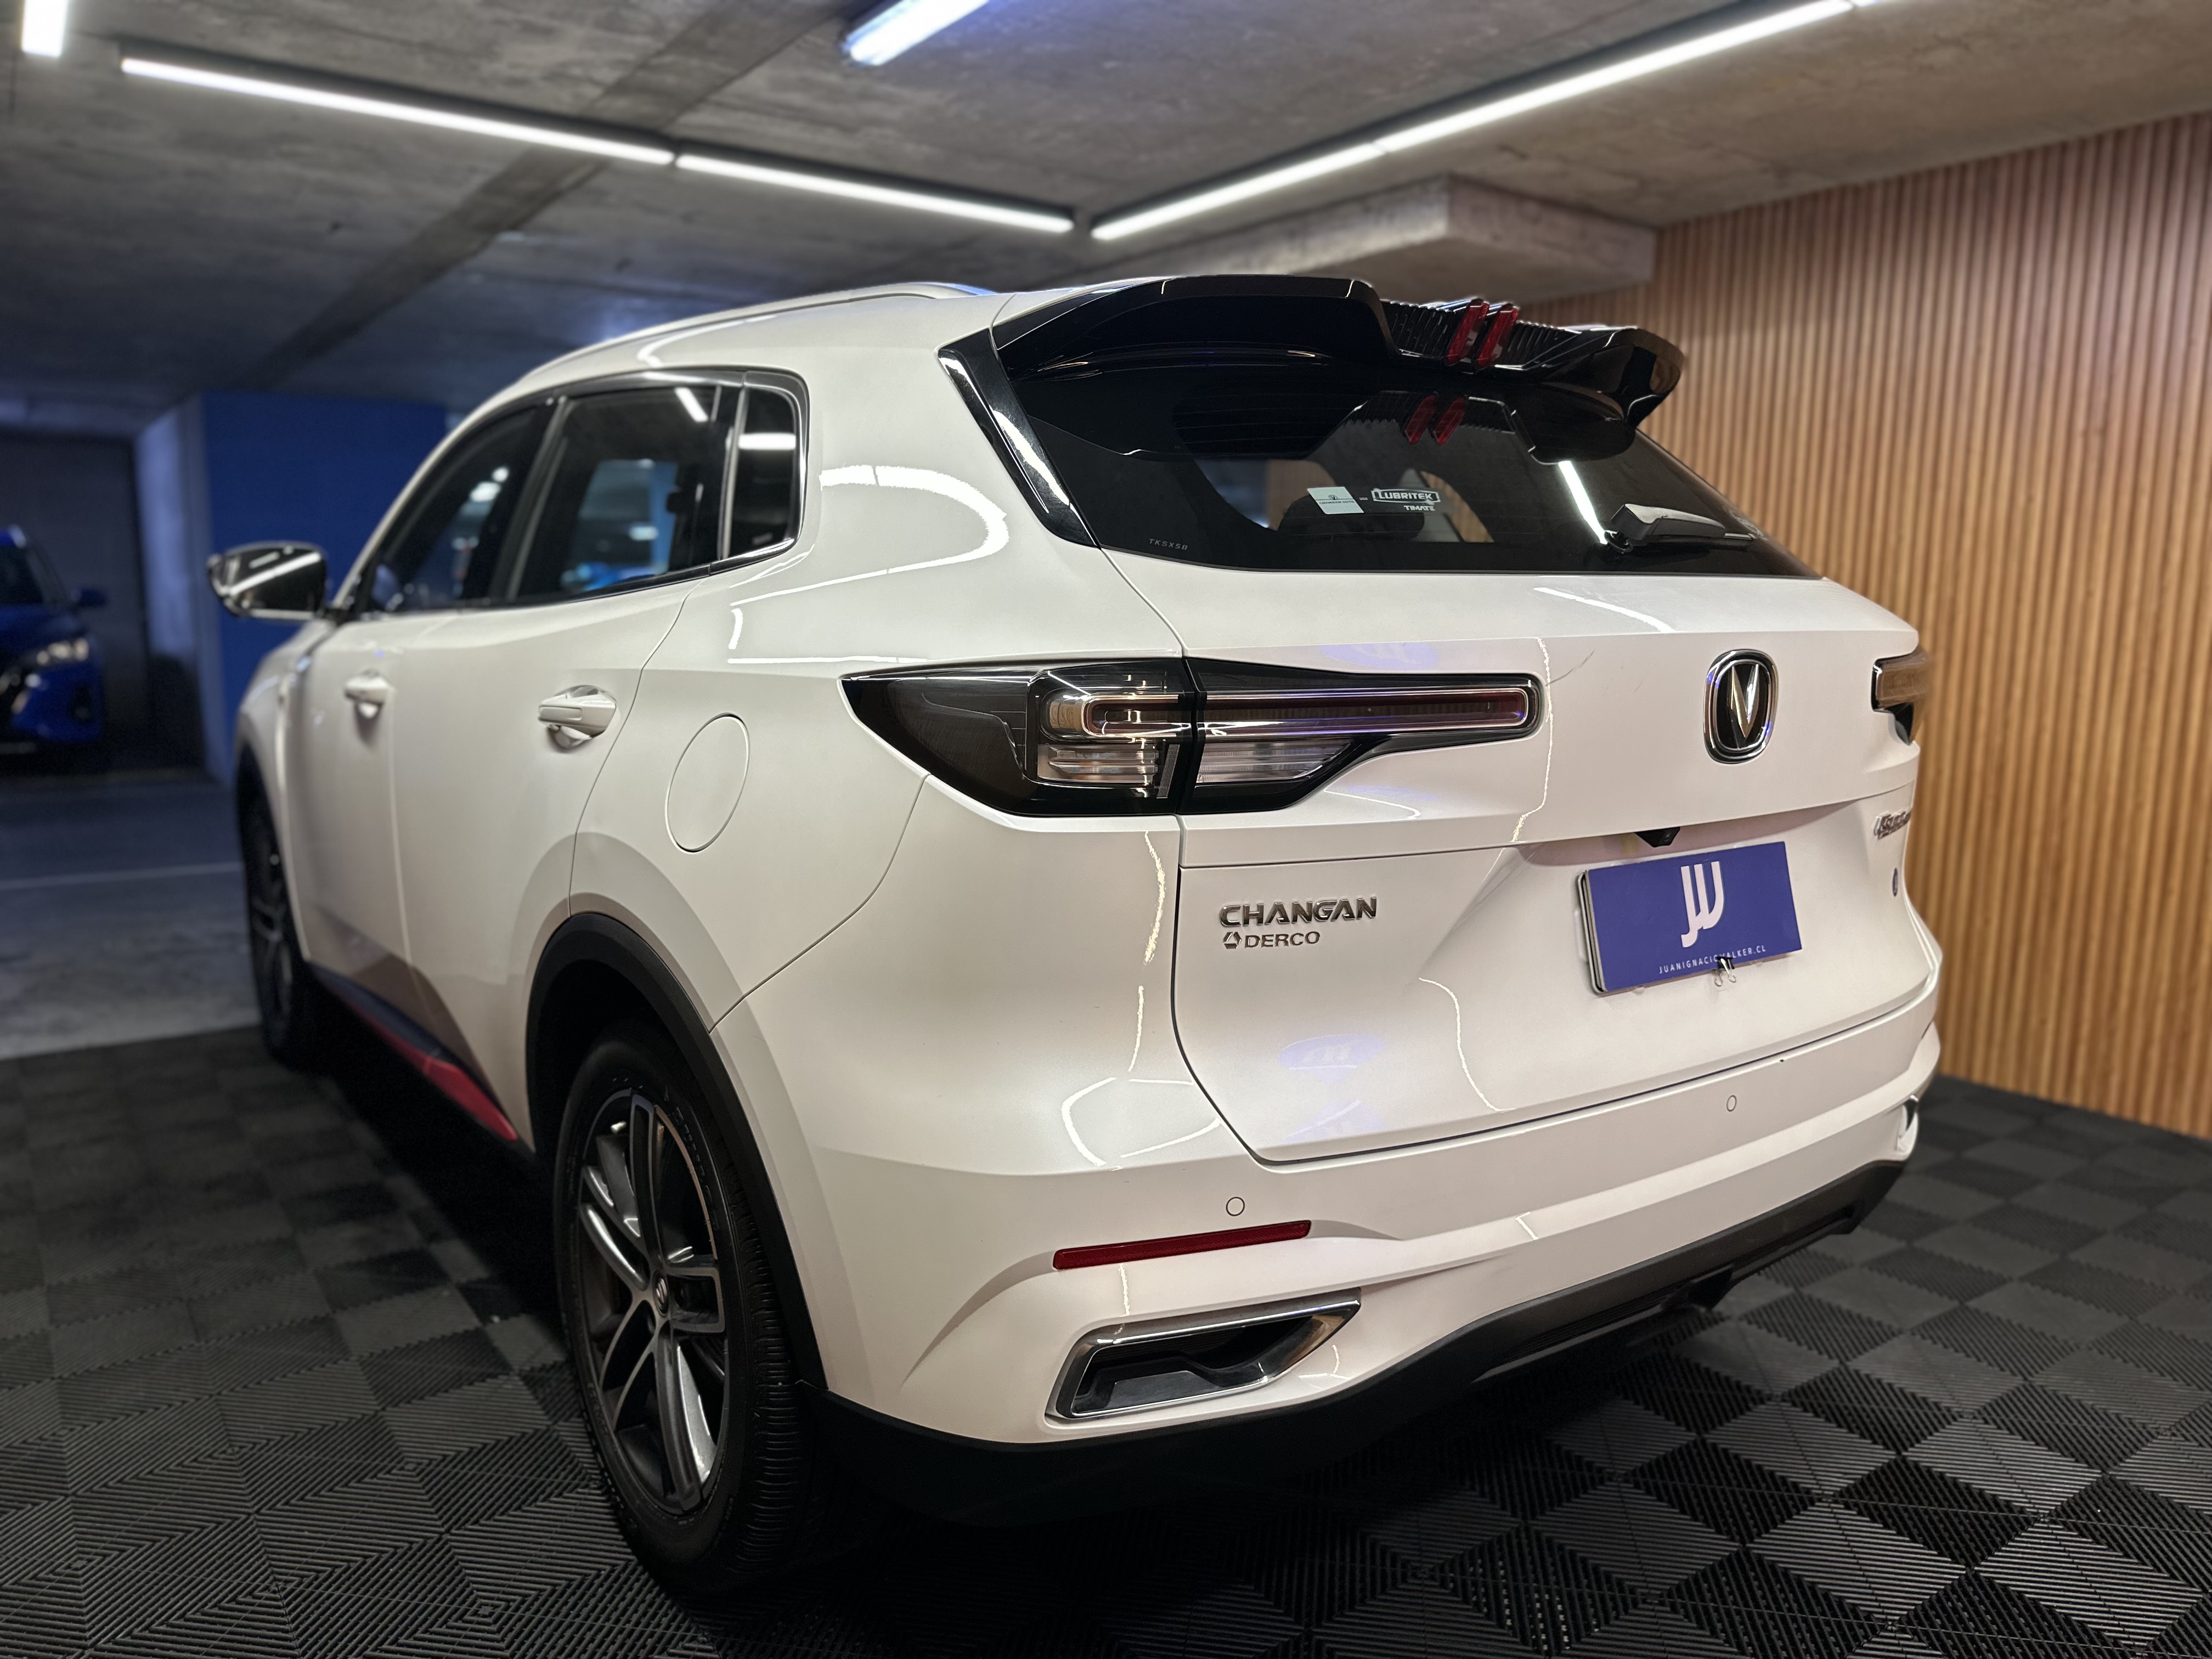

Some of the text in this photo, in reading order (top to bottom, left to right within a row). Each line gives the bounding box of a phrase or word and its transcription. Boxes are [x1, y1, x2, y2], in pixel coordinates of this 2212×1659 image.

[1378, 492, 1434, 500] LUBRITEK
[1149, 538, 1188, 550] TKSX58
[1219, 896, 1378, 927] CHANGAN
[1244, 931, 1321, 949] DERCO
